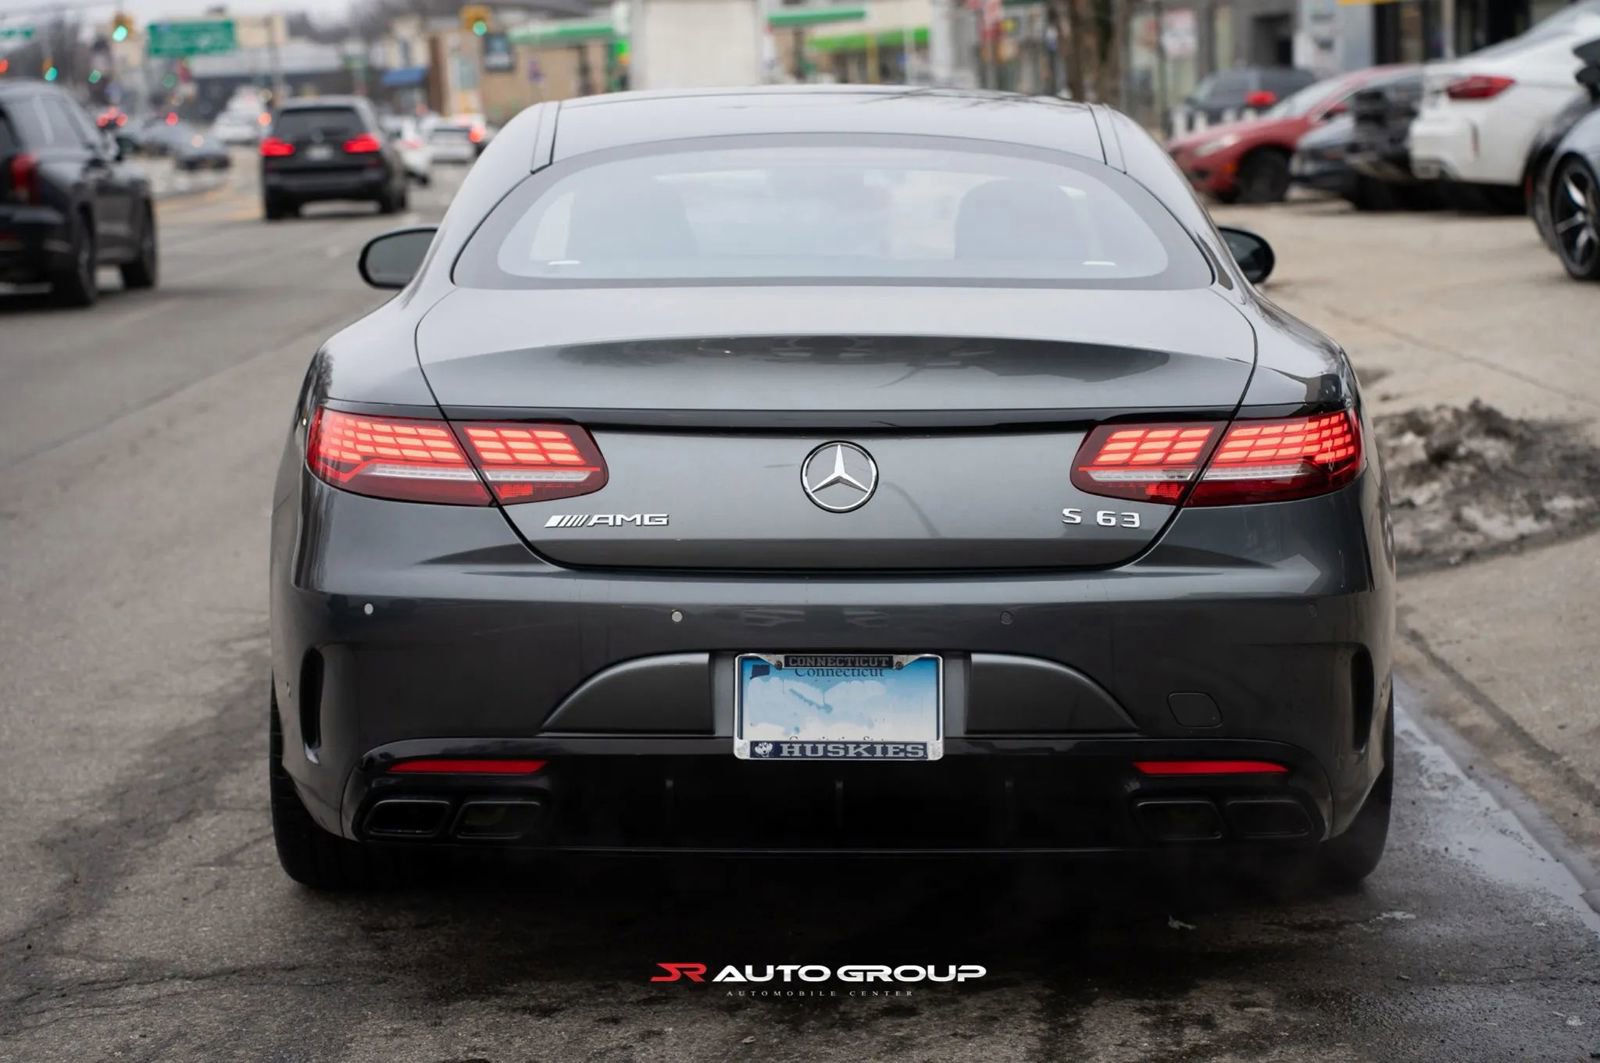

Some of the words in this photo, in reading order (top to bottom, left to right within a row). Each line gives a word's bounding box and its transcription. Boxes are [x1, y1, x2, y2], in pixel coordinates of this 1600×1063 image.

[586, 513, 669, 528] AMG
[1061, 507, 1082, 525] S
[1096, 510, 1141, 529] 63
[788, 656, 890, 667] CONNECTICUT
[794, 667, 885, 678] Connecticut
[779, 743, 924, 758] HUSKIES
